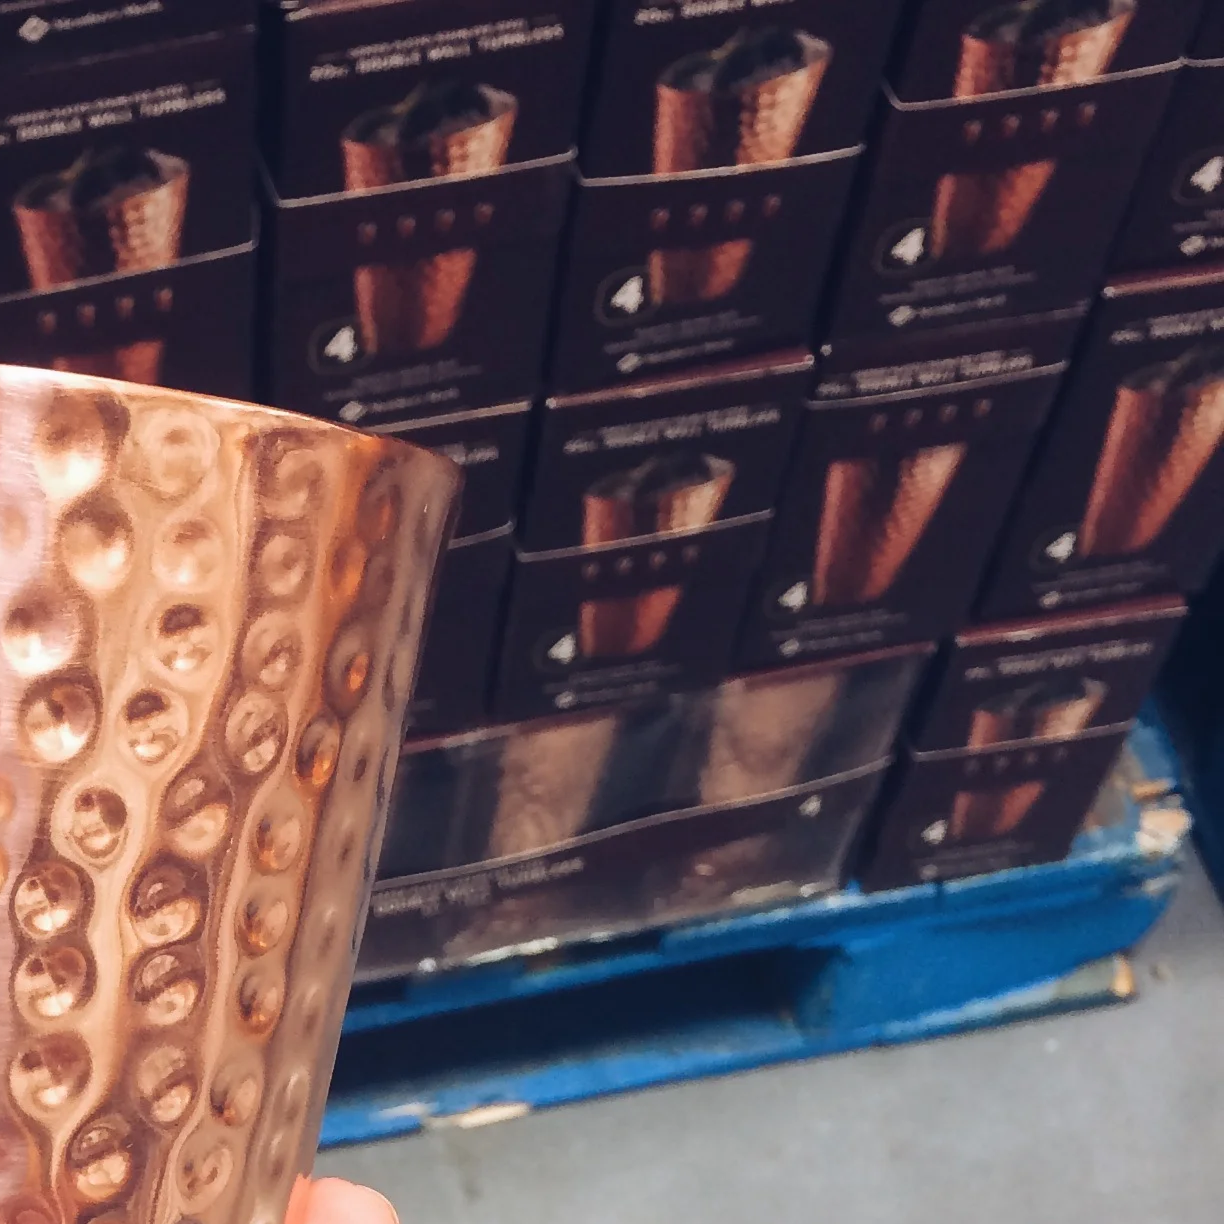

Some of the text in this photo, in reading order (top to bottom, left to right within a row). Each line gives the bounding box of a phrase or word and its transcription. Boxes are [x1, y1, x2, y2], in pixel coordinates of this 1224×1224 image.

[891, 227, 925, 266] 4
[610, 275, 644, 314] 4
[324, 325, 358, 363] 4
